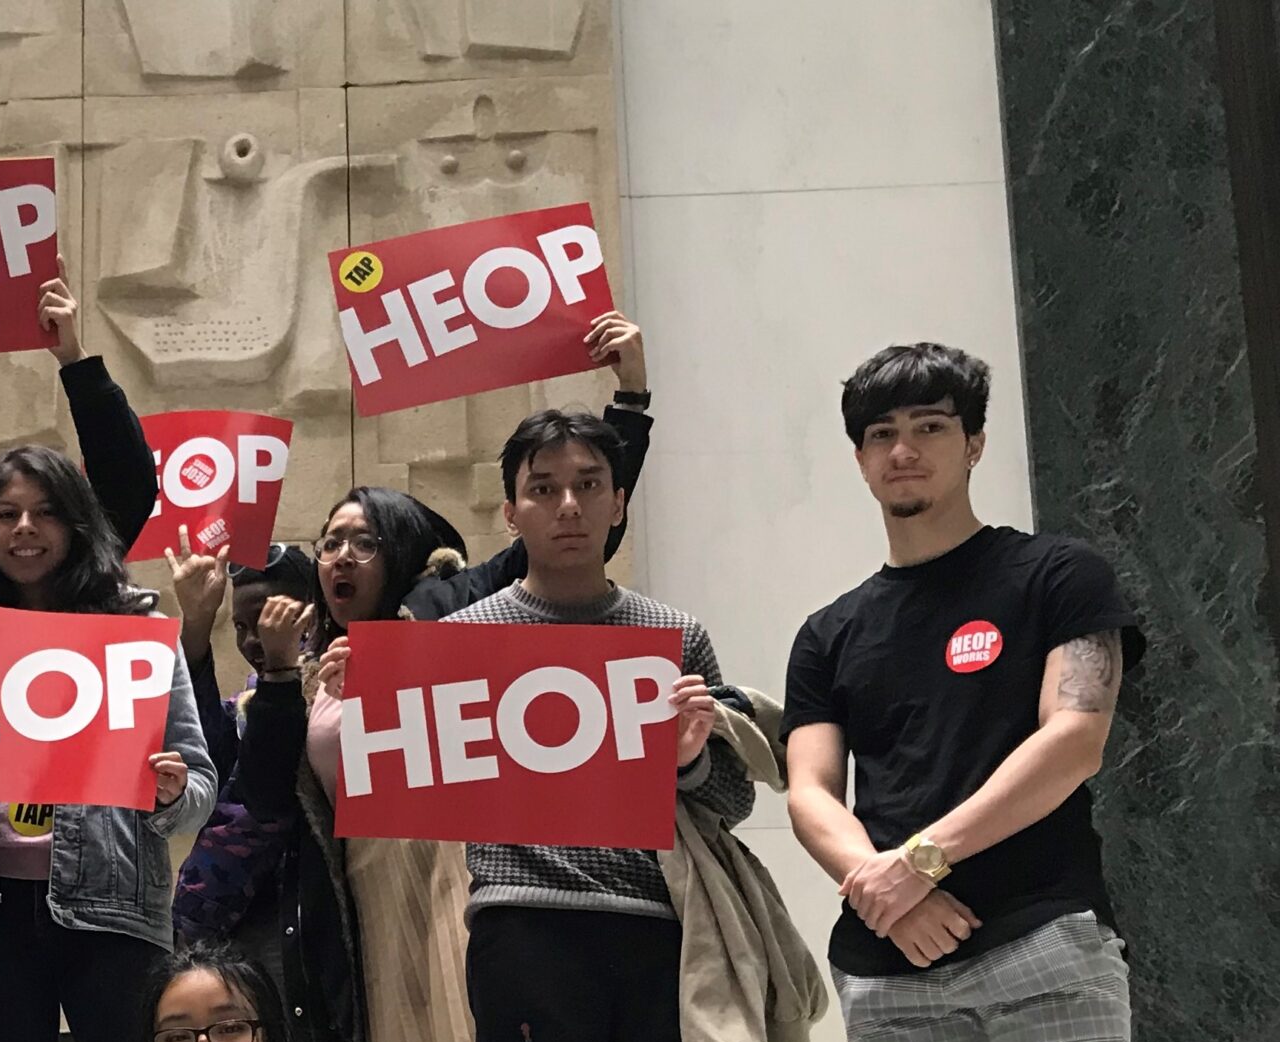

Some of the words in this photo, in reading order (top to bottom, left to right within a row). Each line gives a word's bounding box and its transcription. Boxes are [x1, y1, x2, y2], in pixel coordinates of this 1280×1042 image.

[345, 256, 375, 286] TAP
[339, 225, 604, 386] HEOP
[196, 518, 226, 544] HEOP
[951, 631, 998, 656] HEOP
[952, 650, 991, 666] WORKS
[340, 656, 682, 797] HEOP
